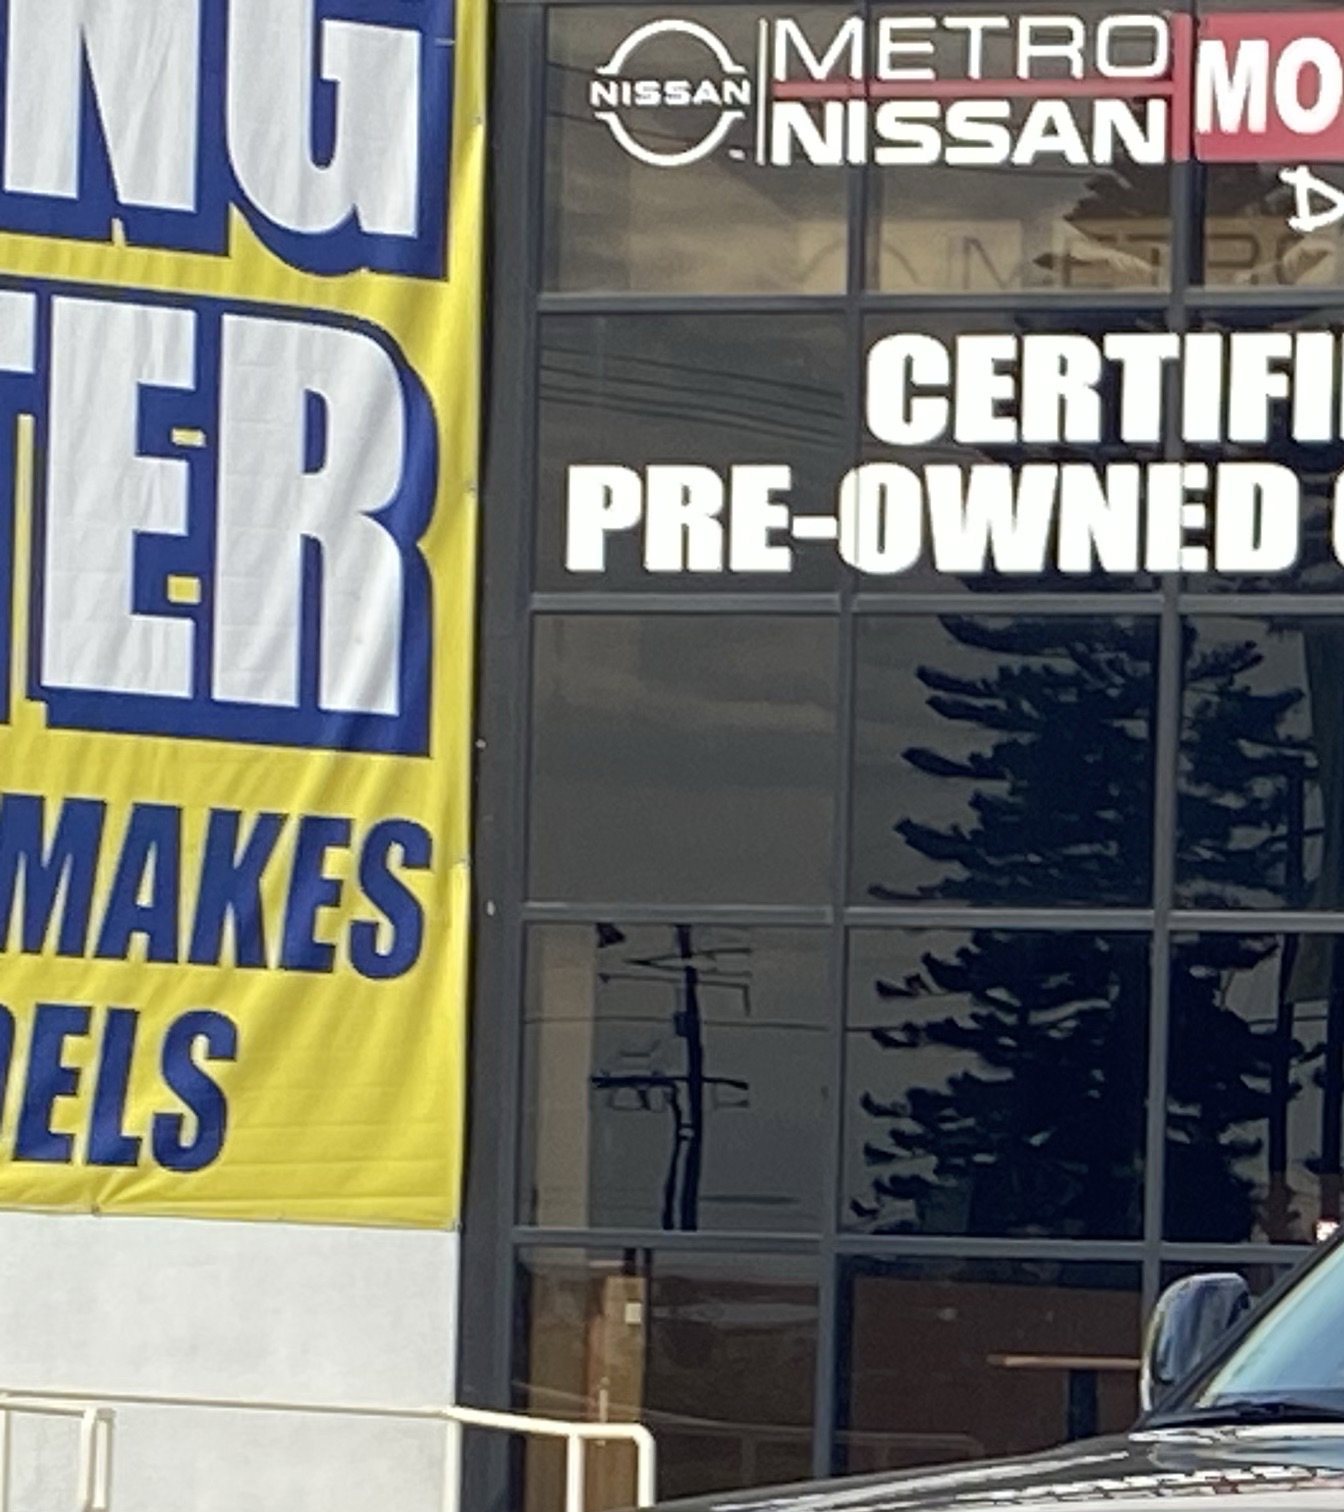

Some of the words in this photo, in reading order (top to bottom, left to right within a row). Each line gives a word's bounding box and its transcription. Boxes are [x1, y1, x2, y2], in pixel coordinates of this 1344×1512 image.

[589, 79, 751, 106] NISSAN
[773, 14, 1169, 81] METRO
[771, 98, 1167, 165] NISSAN
[566, 461, 1300, 574] PRE-OWNED
[0, 792, 433, 981] MAKES
[0, 1002, 240, 1172] ELS
